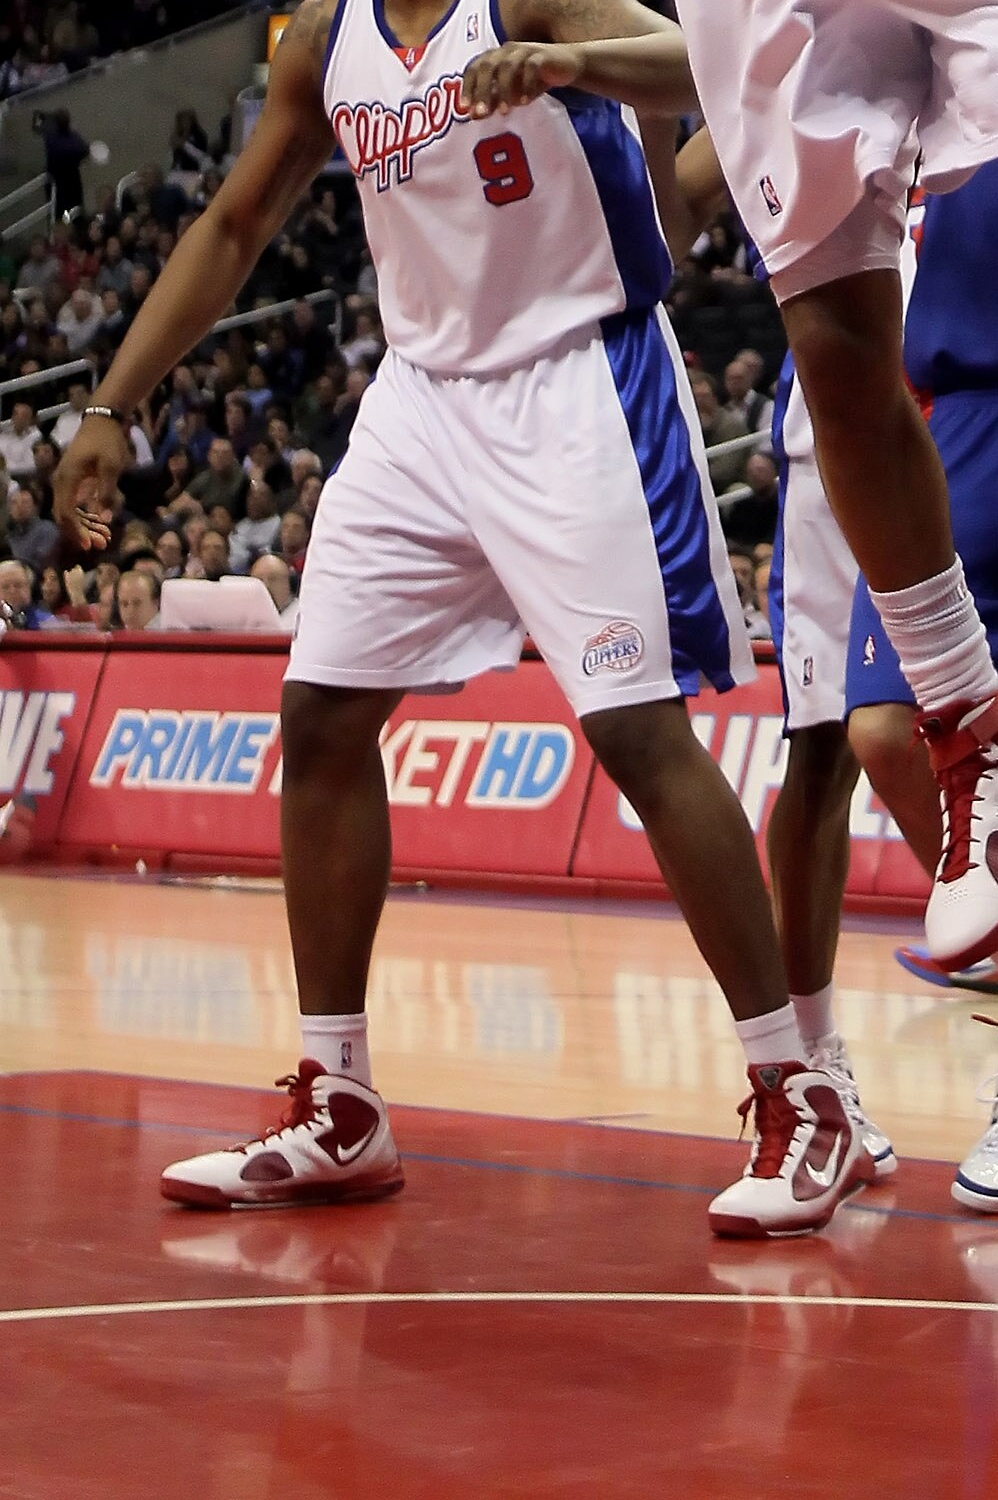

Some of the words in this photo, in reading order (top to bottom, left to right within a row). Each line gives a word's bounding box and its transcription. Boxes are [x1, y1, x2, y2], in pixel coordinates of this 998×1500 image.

[331, 71, 473, 193] Clipper
[473, 131, 534, 207] 9
[0, 689, 76, 794] VE
[89, 708, 282, 795] PRIME
[463, 721, 577, 810] HD
